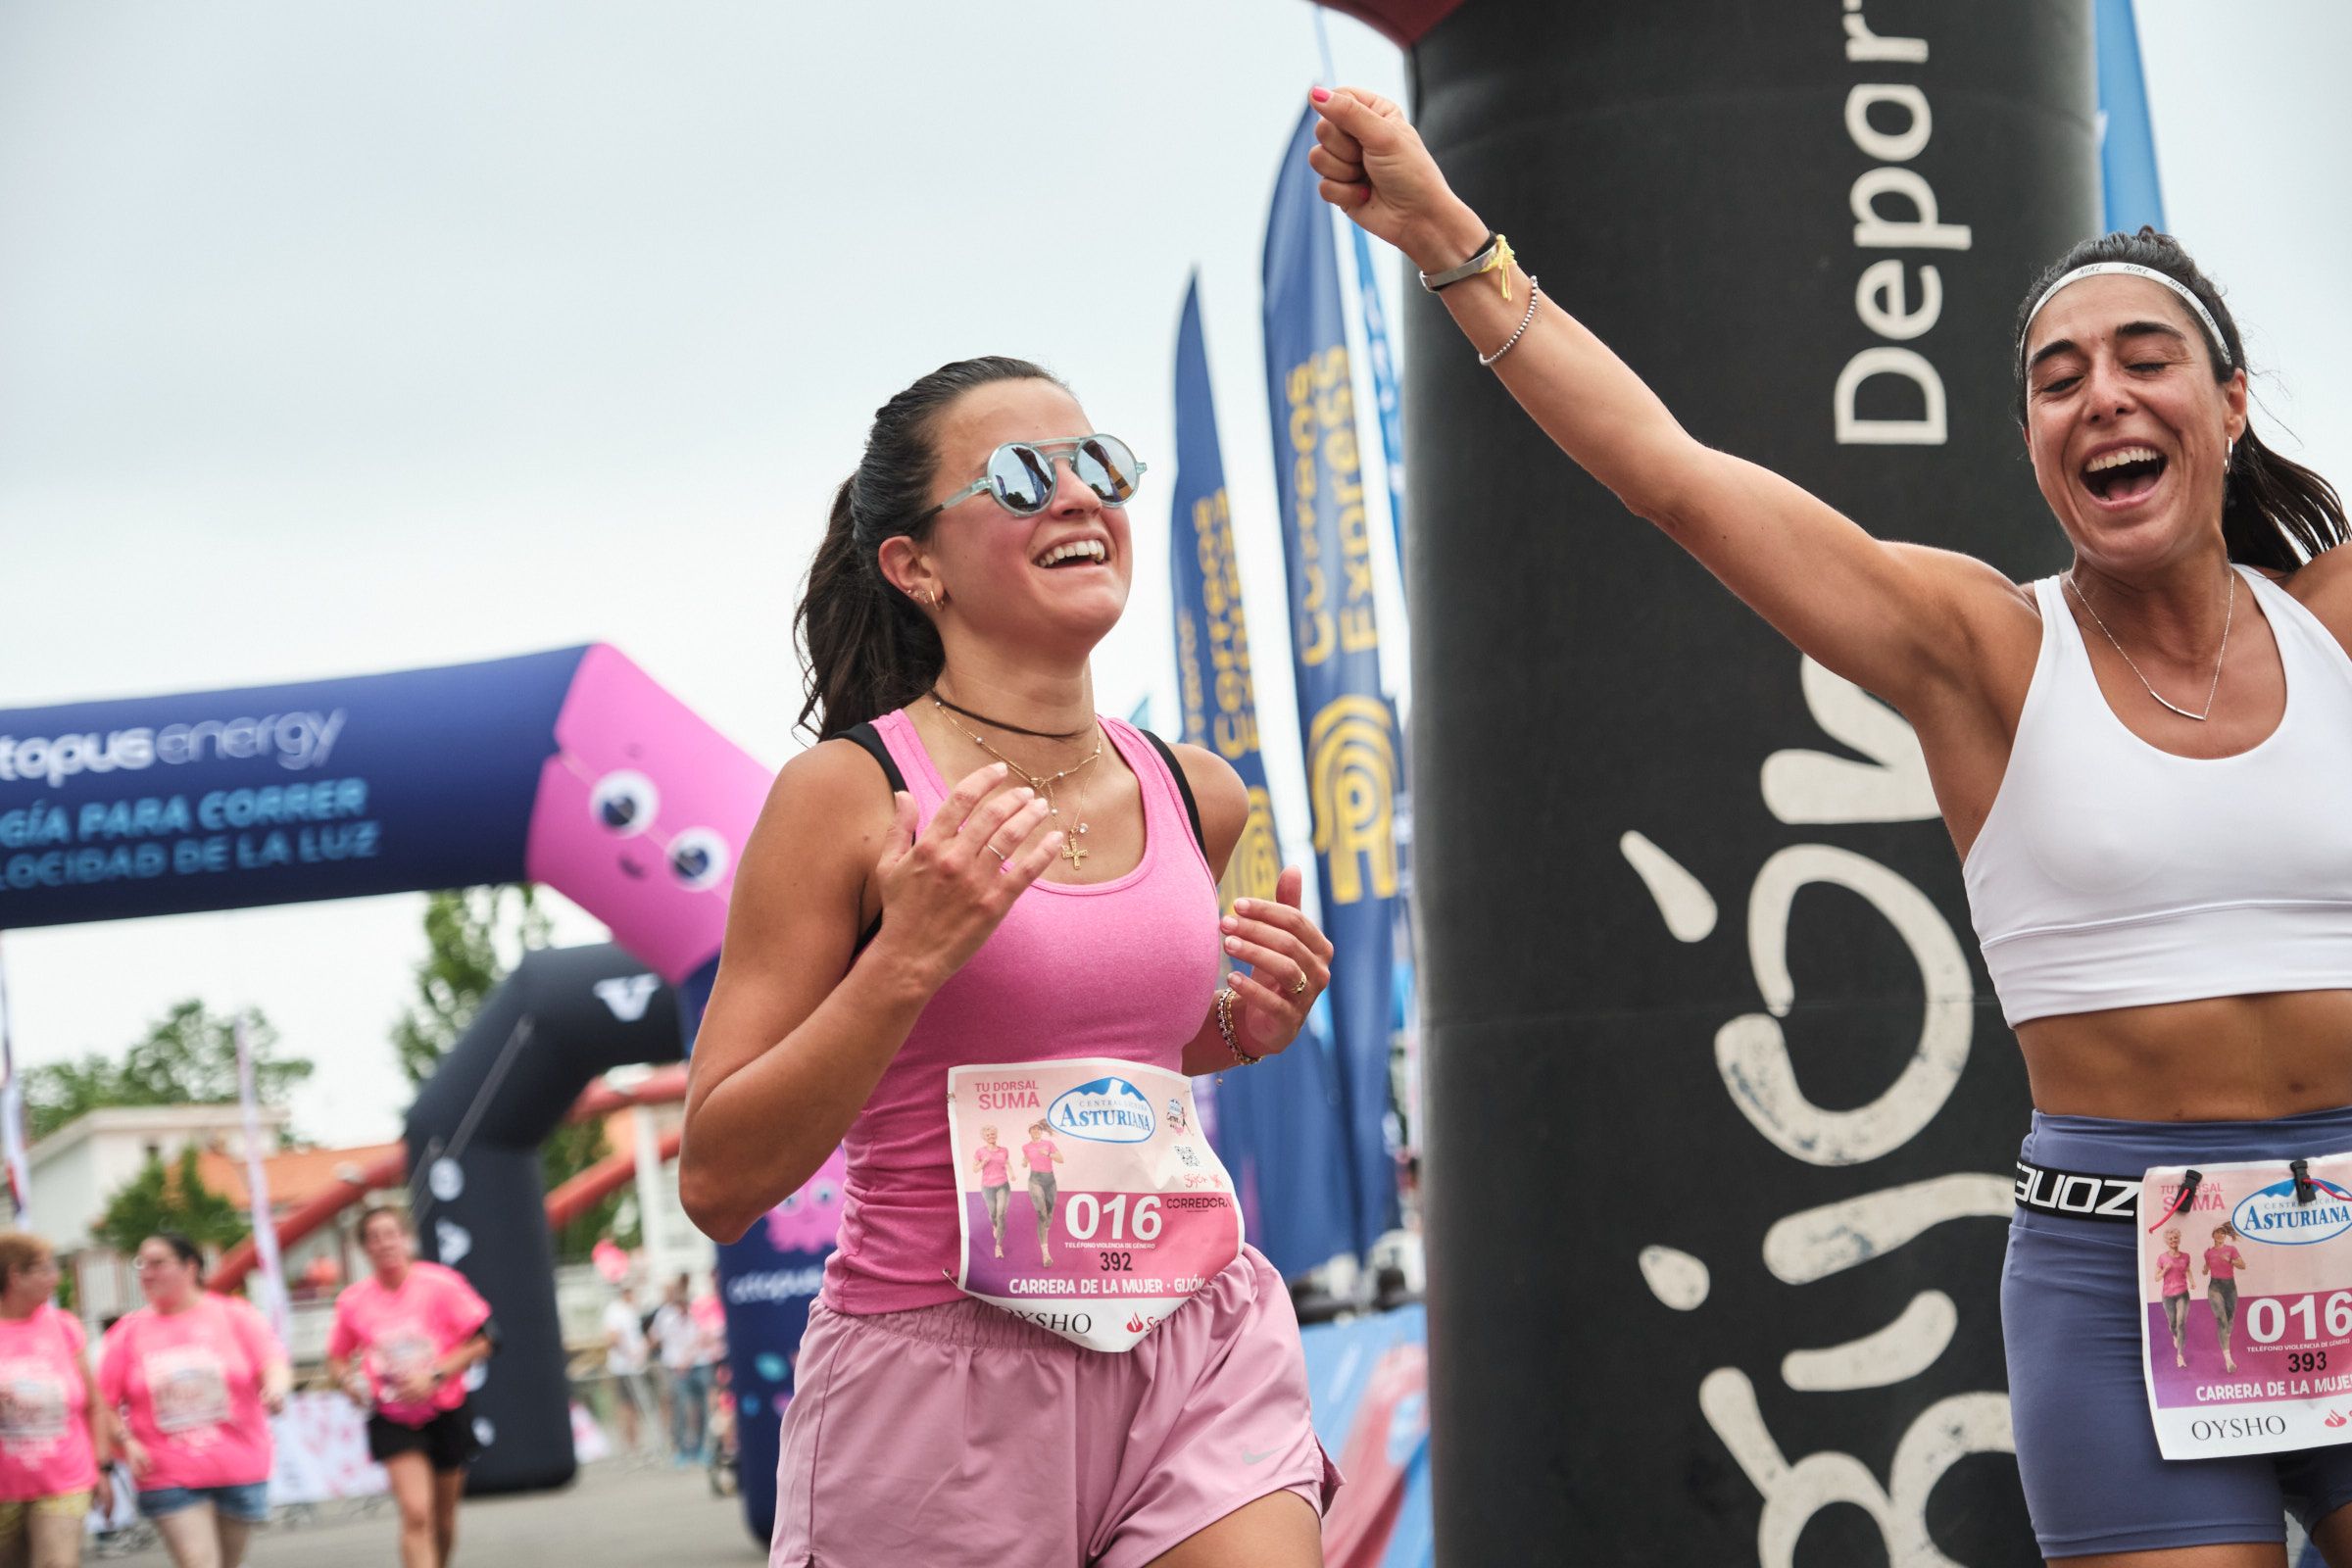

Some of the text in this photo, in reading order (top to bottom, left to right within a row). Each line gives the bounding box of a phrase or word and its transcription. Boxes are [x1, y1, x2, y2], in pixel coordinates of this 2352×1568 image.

[1835, 0, 1971, 445] Depor
[2078, 264, 2102, 275] NIKE
[2123, 264, 2149, 275] NIKE
[2168, 278, 2190, 296] NIKE
[2200, 306, 2216, 329] NIKE
[77, 794, 193, 841] PARA
[199, 776, 368, 831] CORRER
[0, 819, 380, 891] OCIDAD DE LA LUZ
[974, 1080, 1040, 1093] TU DORSAL
[978, 1091, 1041, 1110] SUMA
[1059, 1102, 1152, 1132] ASTURIANA
[2160, 1184, 2174, 1194] TU
[2163, 1194, 2226, 1213] SMA
[1064, 1193, 1163, 1240] 016
[2243, 1204, 2352, 1232] ASTURIANA
[1100, 1251, 1133, 1271] 392
[1008, 1278, 1076, 1295] CARRERA
[1080, 1278, 1099, 1295] DE
[1102, 1279, 1119, 1295] LA
[1122, 1278, 1164, 1294] MUJER
[2245, 1291, 2352, 1345] 016
[2283, 1343, 2321, 1351] VIOLENCIA
[2287, 1350, 2328, 1373] 393
[2195, 1373, 2352, 1402] CARRERA DE LA MUJE
[2190, 1414, 2286, 1442] OYSHO
